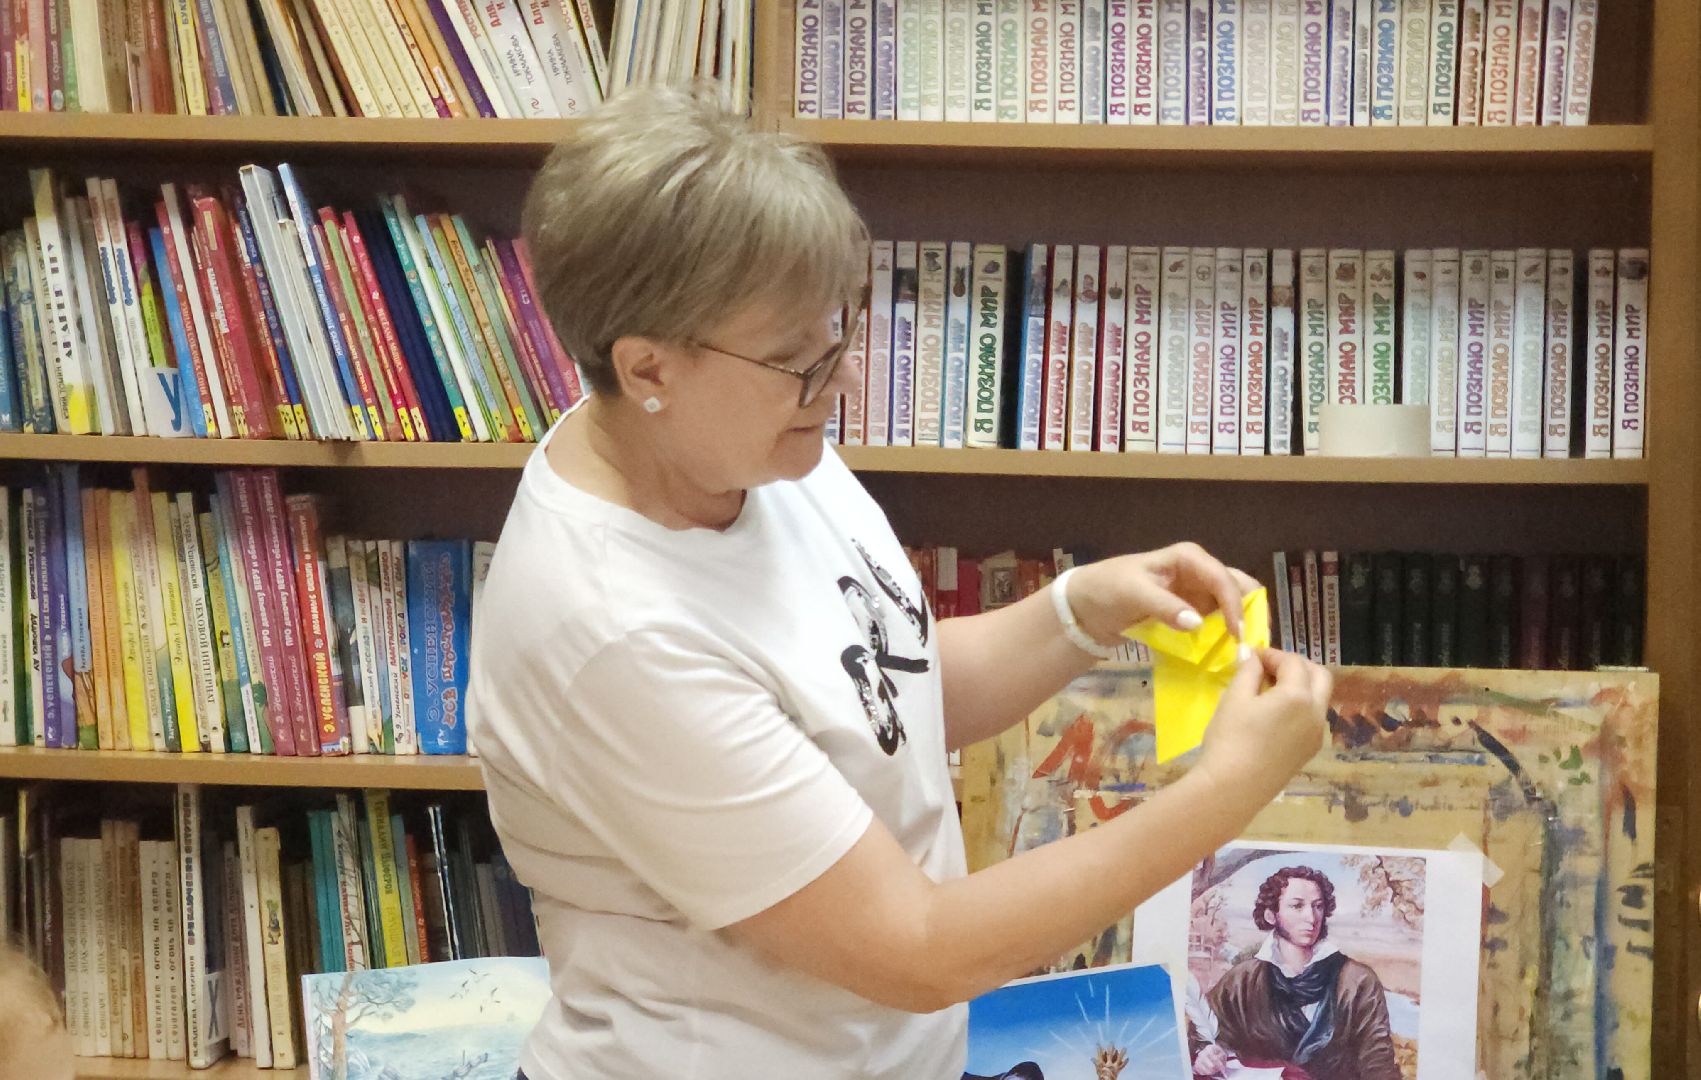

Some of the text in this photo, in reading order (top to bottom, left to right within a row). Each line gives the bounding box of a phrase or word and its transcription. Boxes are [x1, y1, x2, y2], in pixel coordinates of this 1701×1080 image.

[506, 50, 521, 77] ИРИНА
[510, 34, 535, 85] ТОКМАКОВА
[547, 48, 559, 76] ИРИНА
[552, 33, 573, 85] ТОКМАКОВА
[799, 15, 819, 113] Я ПОЗНАЮ
[847, 16, 867, 114] Я ПОЗНАЮ
[974, 21, 992, 111] Я ПОЗНАЮ
[1029, 17, 1050, 113] Я ПОЗНАЮ
[1058, 21, 1076, 111] Я ПОЗНАЮ
[1109, 23, 1126, 115] Я ПОЗНАЮ
[1134, 24, 1152, 116] Я ПОЗНАЮ
[1215, 21, 1235, 121] Я ПОЗНАЮ
[1301, 22, 1322, 122] Я ПОЗНАЮ
[1373, 18, 1395, 120] Я ПОЗНАЮ
[1433, 22, 1454, 115] Я ПОЗНАЮ
[1487, 25, 1510, 123] Я ПОЗНАЮ
[974, 285, 999, 433] Я ПОЗНАЮ МИР
[1131, 283, 1152, 434] Я ПОЗНАЮ МИР
[1193, 298, 1213, 435] Я ПОЗНАЮ МИР
[1246, 297, 1264, 434] Я ПОЗНАЮ МИР
[1307, 298, 1325, 337] МИР
[1464, 297, 1485, 434] Я ПОЗНАЮ МИР
[894, 316, 912, 439] Я ПОЗНАЮ МИР
[1023, 319, 1043, 443] Я ПОЗНАЮ МИР
[1049, 321, 1068, 443] Я ПОЗНАЮ МИР
[1075, 322, 1094, 444] Я ПОЗНАЮ МИР
[1102, 322, 1121, 444] Я ПОЗНАЮ МИР
[1217, 300, 1238, 434] Я ПОЗНАЮ МИР
[1491, 299, 1512, 437] Я ПОЗНАЮ МИР
[1549, 298, 1569, 437] Я ПОЗНАЮ МИР
[1592, 298, 1612, 438] Я ПОЗНАЮ МИР
[1622, 303, 1641, 431] Я ПОЗНАЮ МИР
[194, 597, 211, 646] МЕХОВОЙ
[251, 568, 264, 590] ВЕРУ
[274, 568, 287, 590] ВЕРУ
[42, 644, 55, 710] УСПЕНСКИЙ
[200, 648, 216, 704] ИНТЕРНАТ
[261, 629, 272, 647] ПРО
[283, 628, 294, 646] ПРО
[420, 563, 438, 698] УСПЕНСКИЙ
[312, 652, 333, 720] УСПЕНСКИЙ
[339, 880, 353, 937] КАНИКУЛЫ
